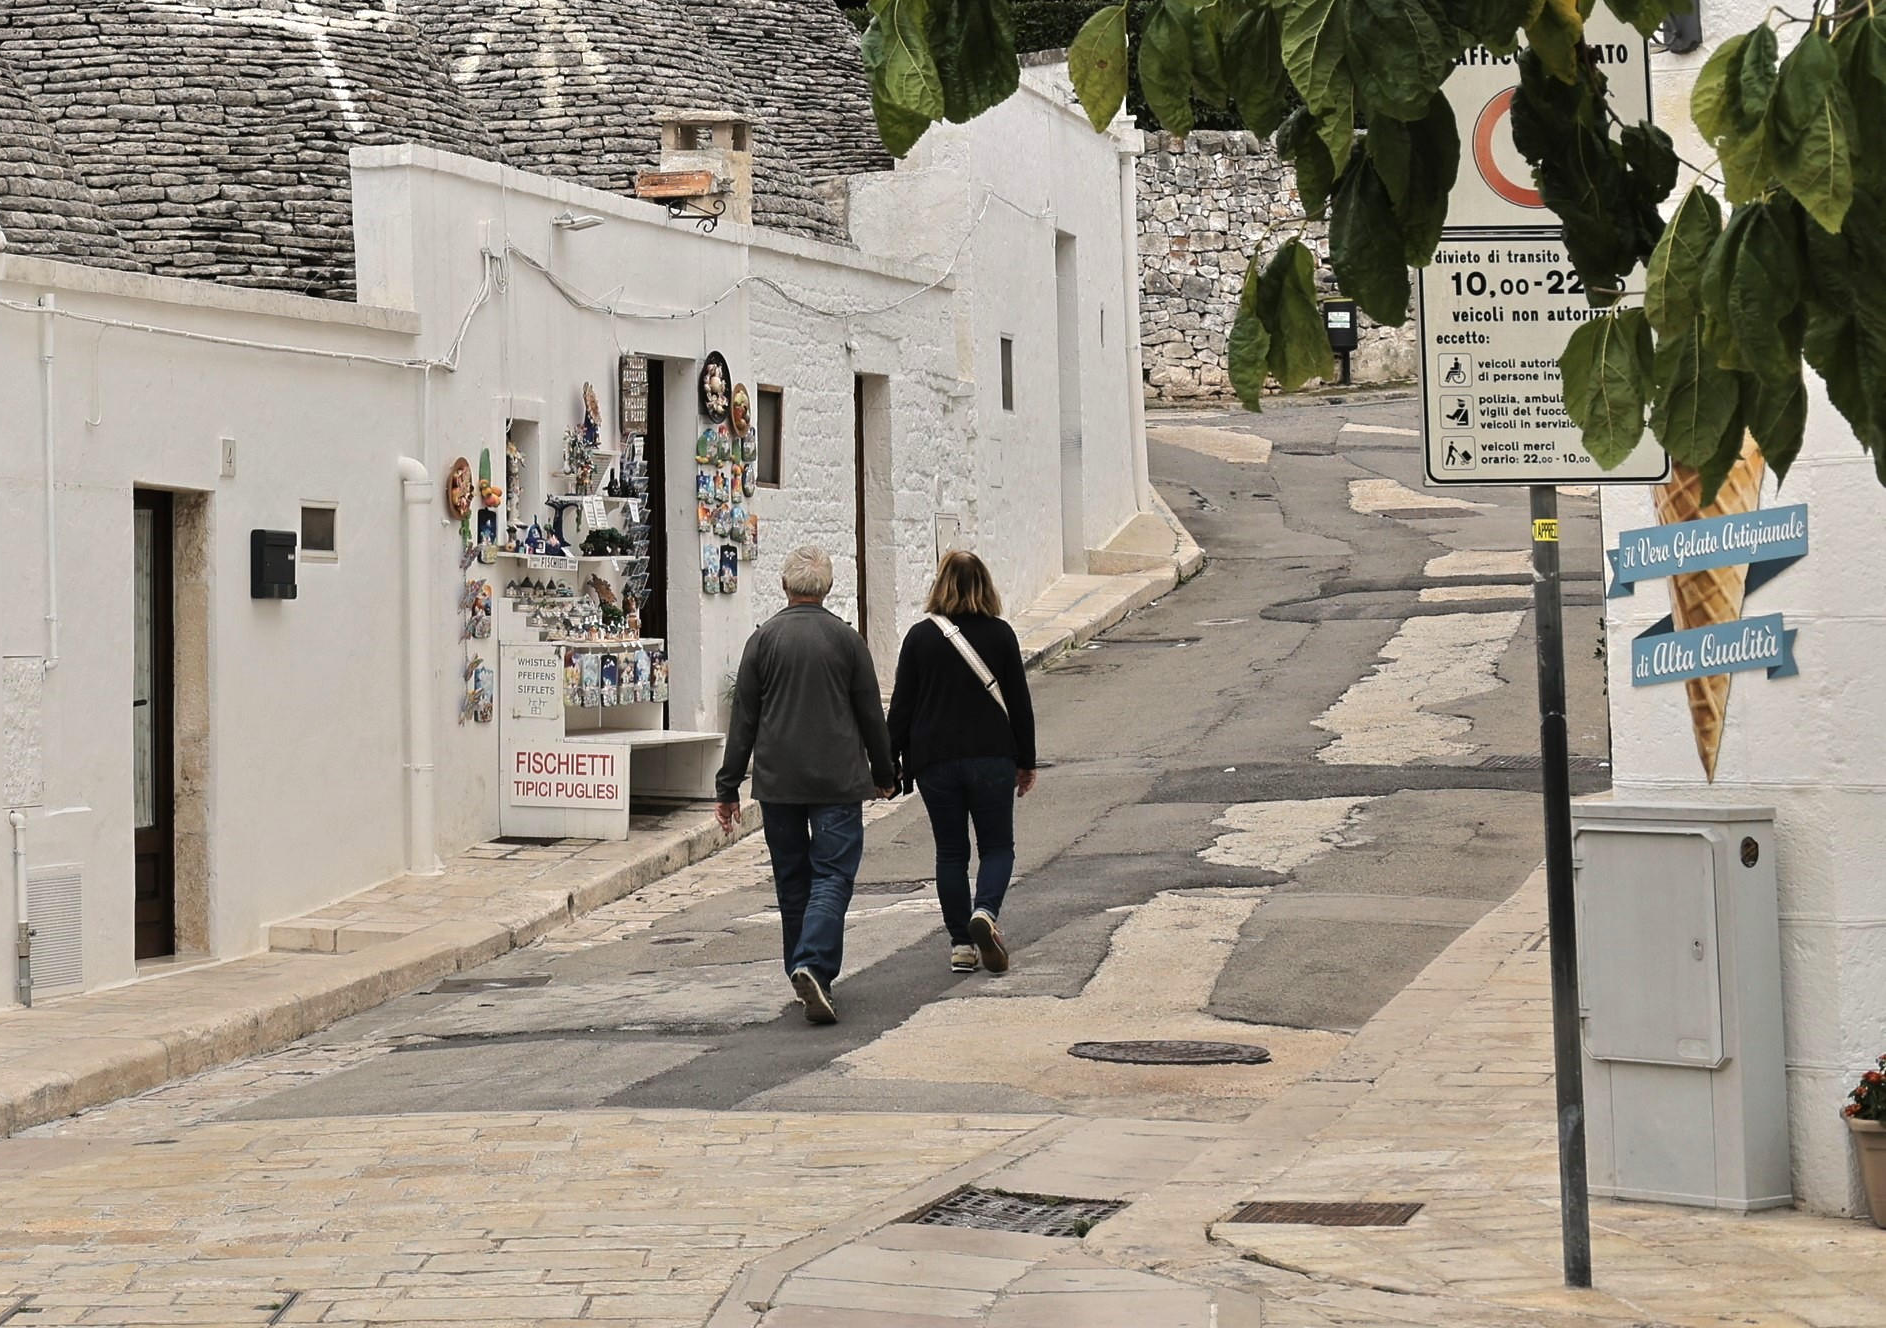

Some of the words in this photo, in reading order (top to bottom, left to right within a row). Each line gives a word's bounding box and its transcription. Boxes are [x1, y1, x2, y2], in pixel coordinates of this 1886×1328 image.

[1435, 250, 1480, 264] divieto
[1488, 250, 1500, 263] di
[1508, 250, 1560, 264] transito
[1452, 306, 1504, 322] veicoli
[1512, 309, 1538, 322] non
[1436, 331, 1490, 345] eccetto:
[1478, 359, 1516, 368] veicoli
[1520, 359, 1559, 368] autoriz
[1478, 372, 1489, 381] di
[1493, 373, 1539, 383] persone
[1479, 394, 1520, 405] polizia,
[1479, 407, 1508, 417] vigili
[1513, 407, 1531, 416] del
[1536, 407, 1568, 416] fuoco
[1480, 420, 1516, 429] veicoli
[1521, 420, 1531, 428] in
[1535, 420, 1577, 429] servizio
[1481, 442, 1519, 451] veicoli
[1523, 442, 1555, 451] merci
[226, 447, 233, 468] 4
[1481, 455, 1520, 464] orario:
[1622, 547, 1637, 569] Il
[1637, 538, 1671, 567] Vero
[1672, 529, 1720, 567] Gelato
[1721, 511, 1806, 555] Artigianale
[1635, 653, 1651, 679] di
[1652, 638, 1696, 676] Alta
[1699, 625, 1780, 668] Qualità
[517, 657, 557, 668] WHISTLES
[517, 672, 556, 681] PFEIFENS
[517, 685, 555, 696] SIFFLETS
[516, 752, 615, 776] FISCHIETTI
[514, 781, 552, 797] TIPICI
[556, 783, 619, 800] PUGLIESI
